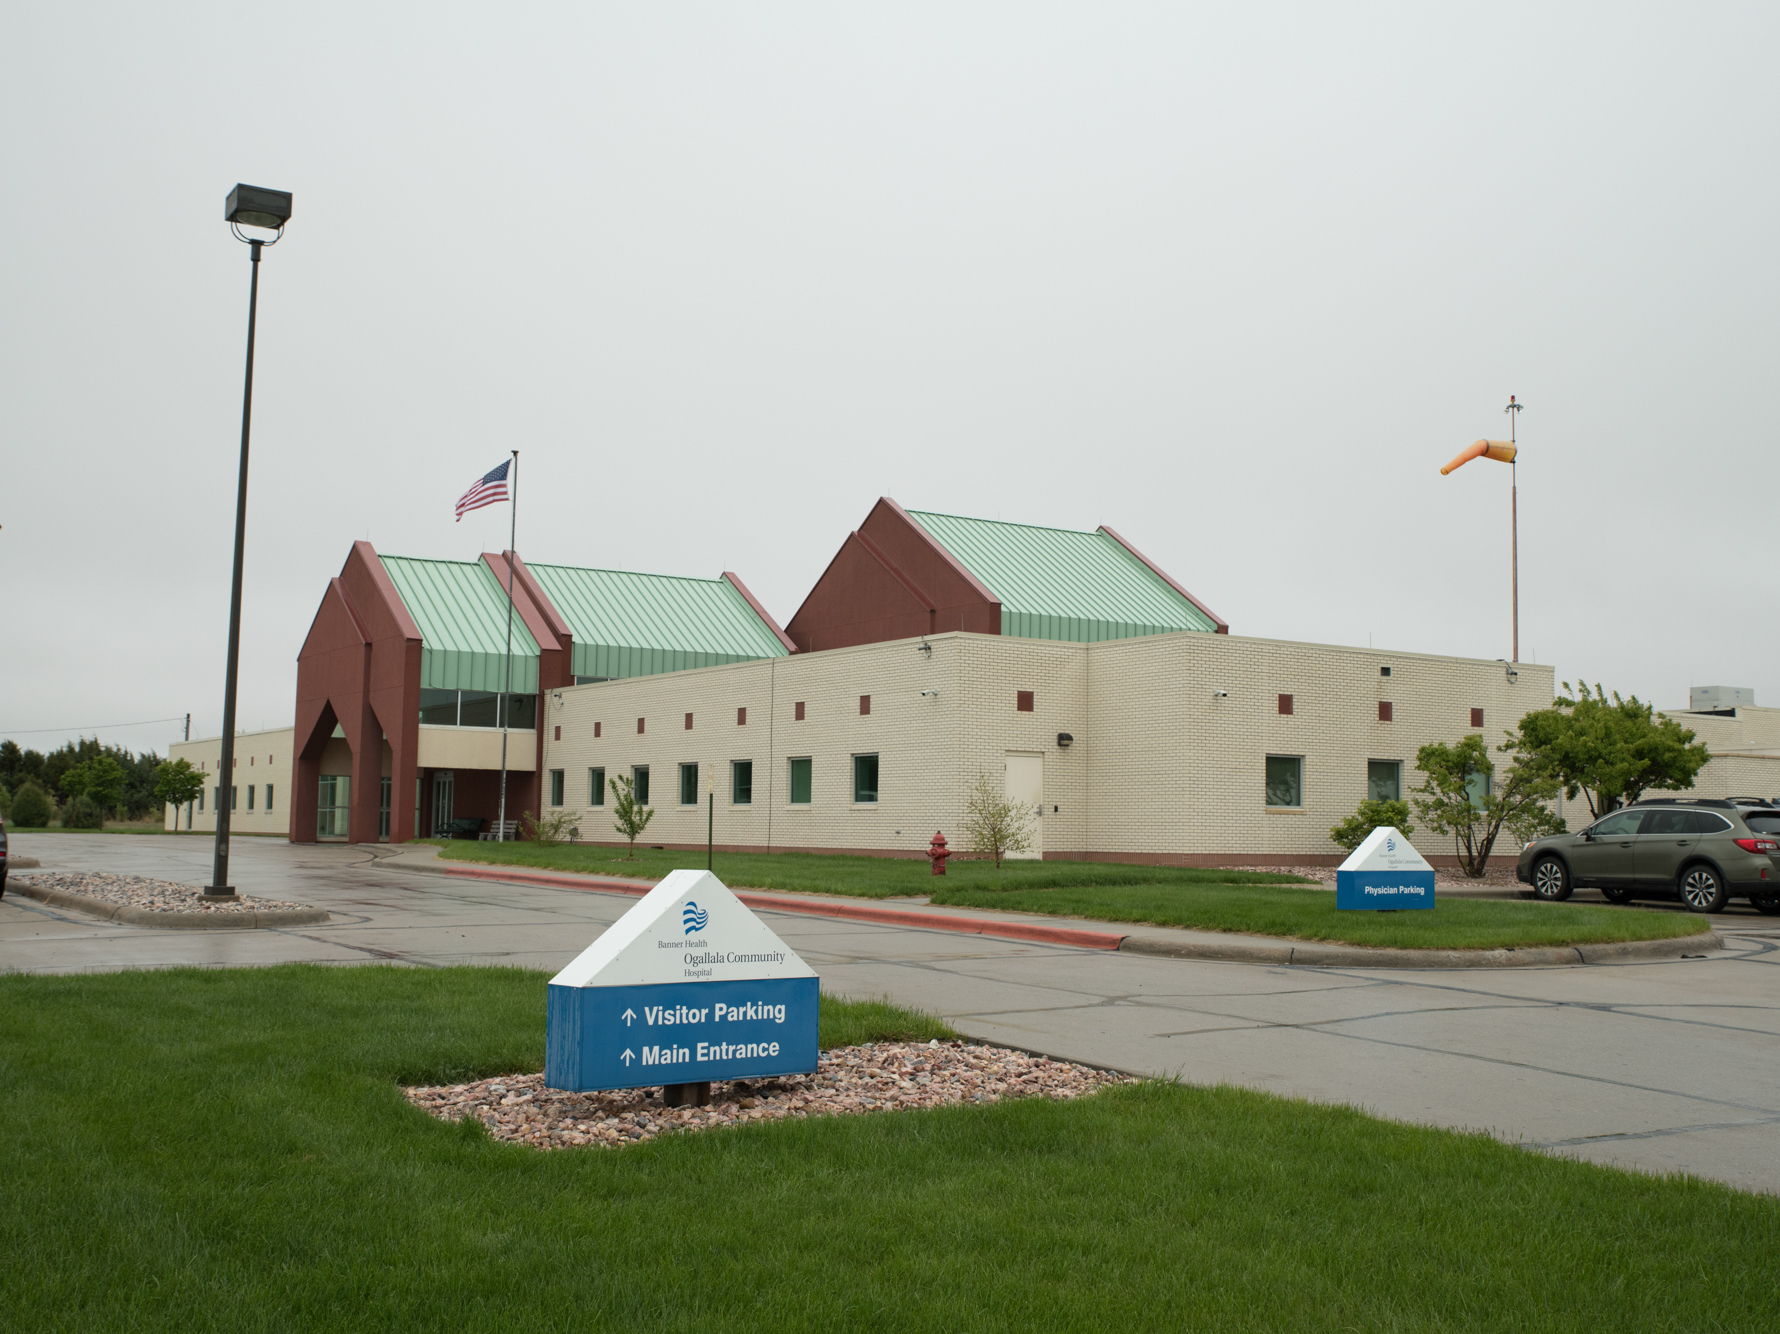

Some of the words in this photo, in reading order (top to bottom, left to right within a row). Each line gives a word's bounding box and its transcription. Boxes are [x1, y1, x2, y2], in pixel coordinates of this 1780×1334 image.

[1365, 886, 1398, 896] Physician
[1399, 886, 1425, 896] Parking
[658, 940, 683, 949] Banner
[685, 939, 708, 948] Health
[684, 952, 725, 967] Ogallala
[726, 951, 785, 964] Community
[684, 968, 712, 978] Hospital
[644, 1005, 709, 1026] Visitor
[715, 1001, 786, 1024] Parking
[642, 1044, 690, 1066] Main
[696, 1041, 780, 1062] Entrance
